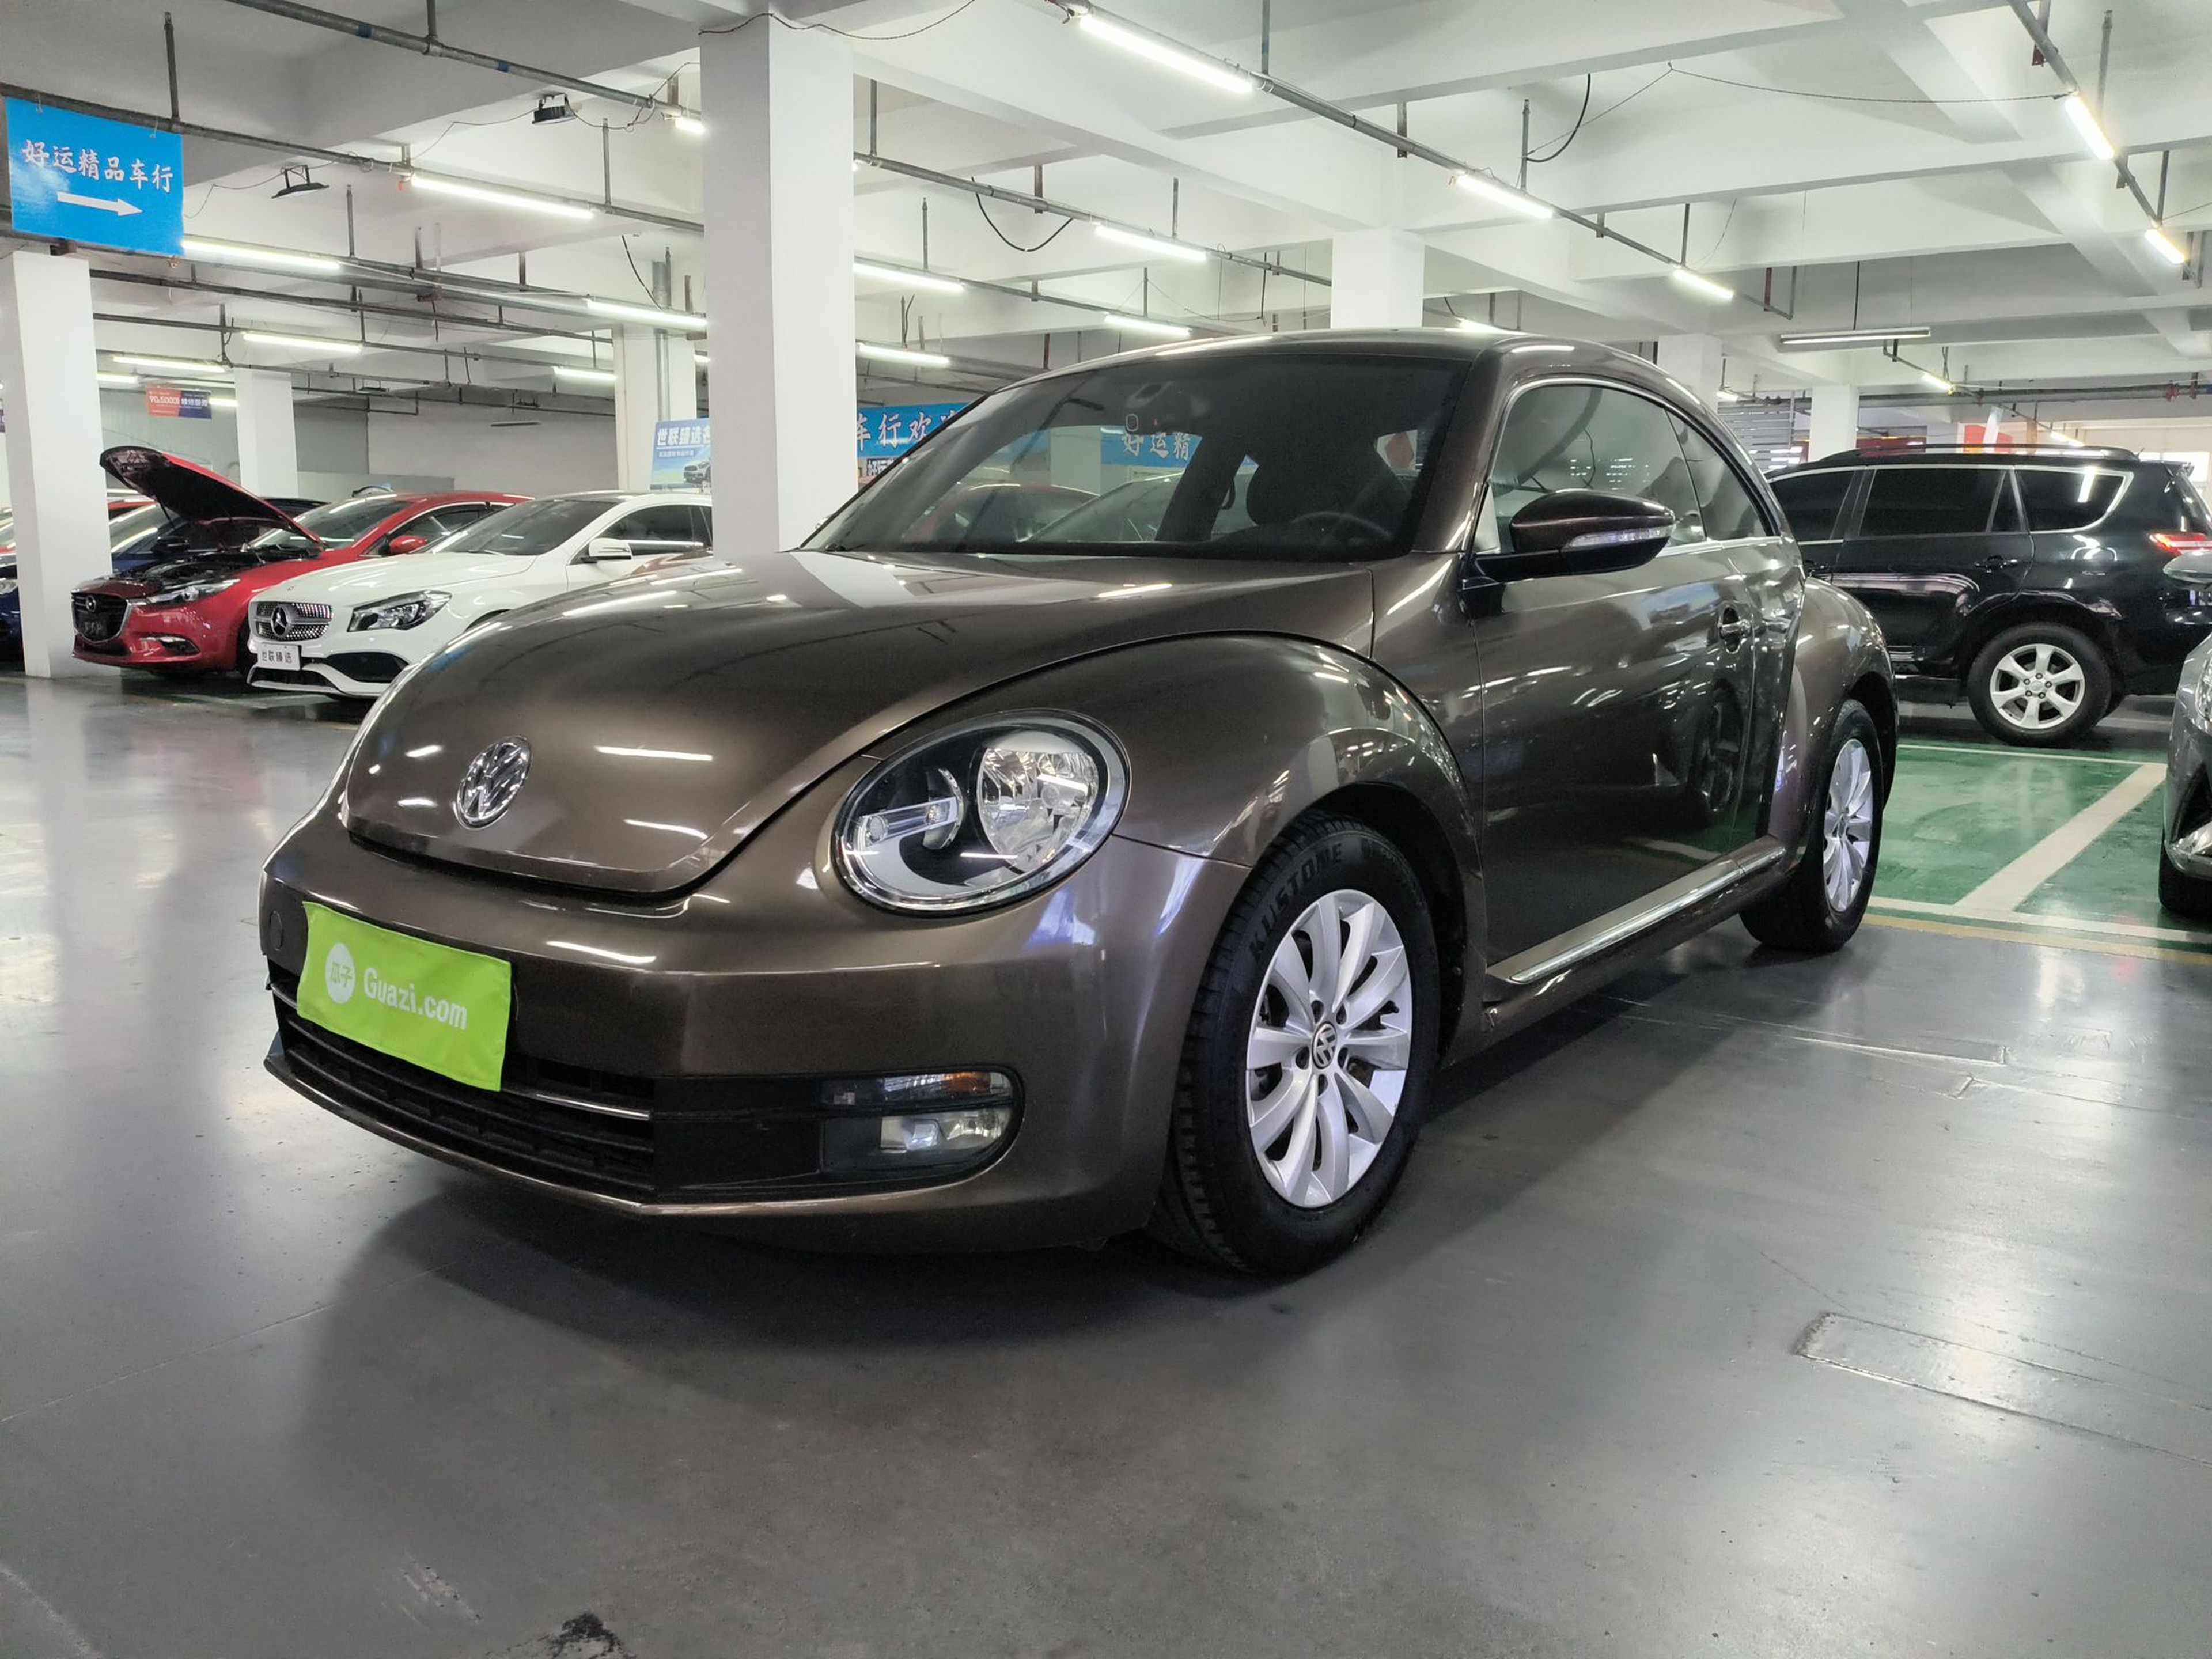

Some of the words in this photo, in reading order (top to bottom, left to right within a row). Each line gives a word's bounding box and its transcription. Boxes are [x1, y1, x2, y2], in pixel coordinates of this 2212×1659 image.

[21, 139, 174, 193] 好运精品车行
[857, 410, 957, 452] 车行欢
[1248, 842, 1343, 961] KUSTONE
[363, 967, 468, 1031] Guazi.com
